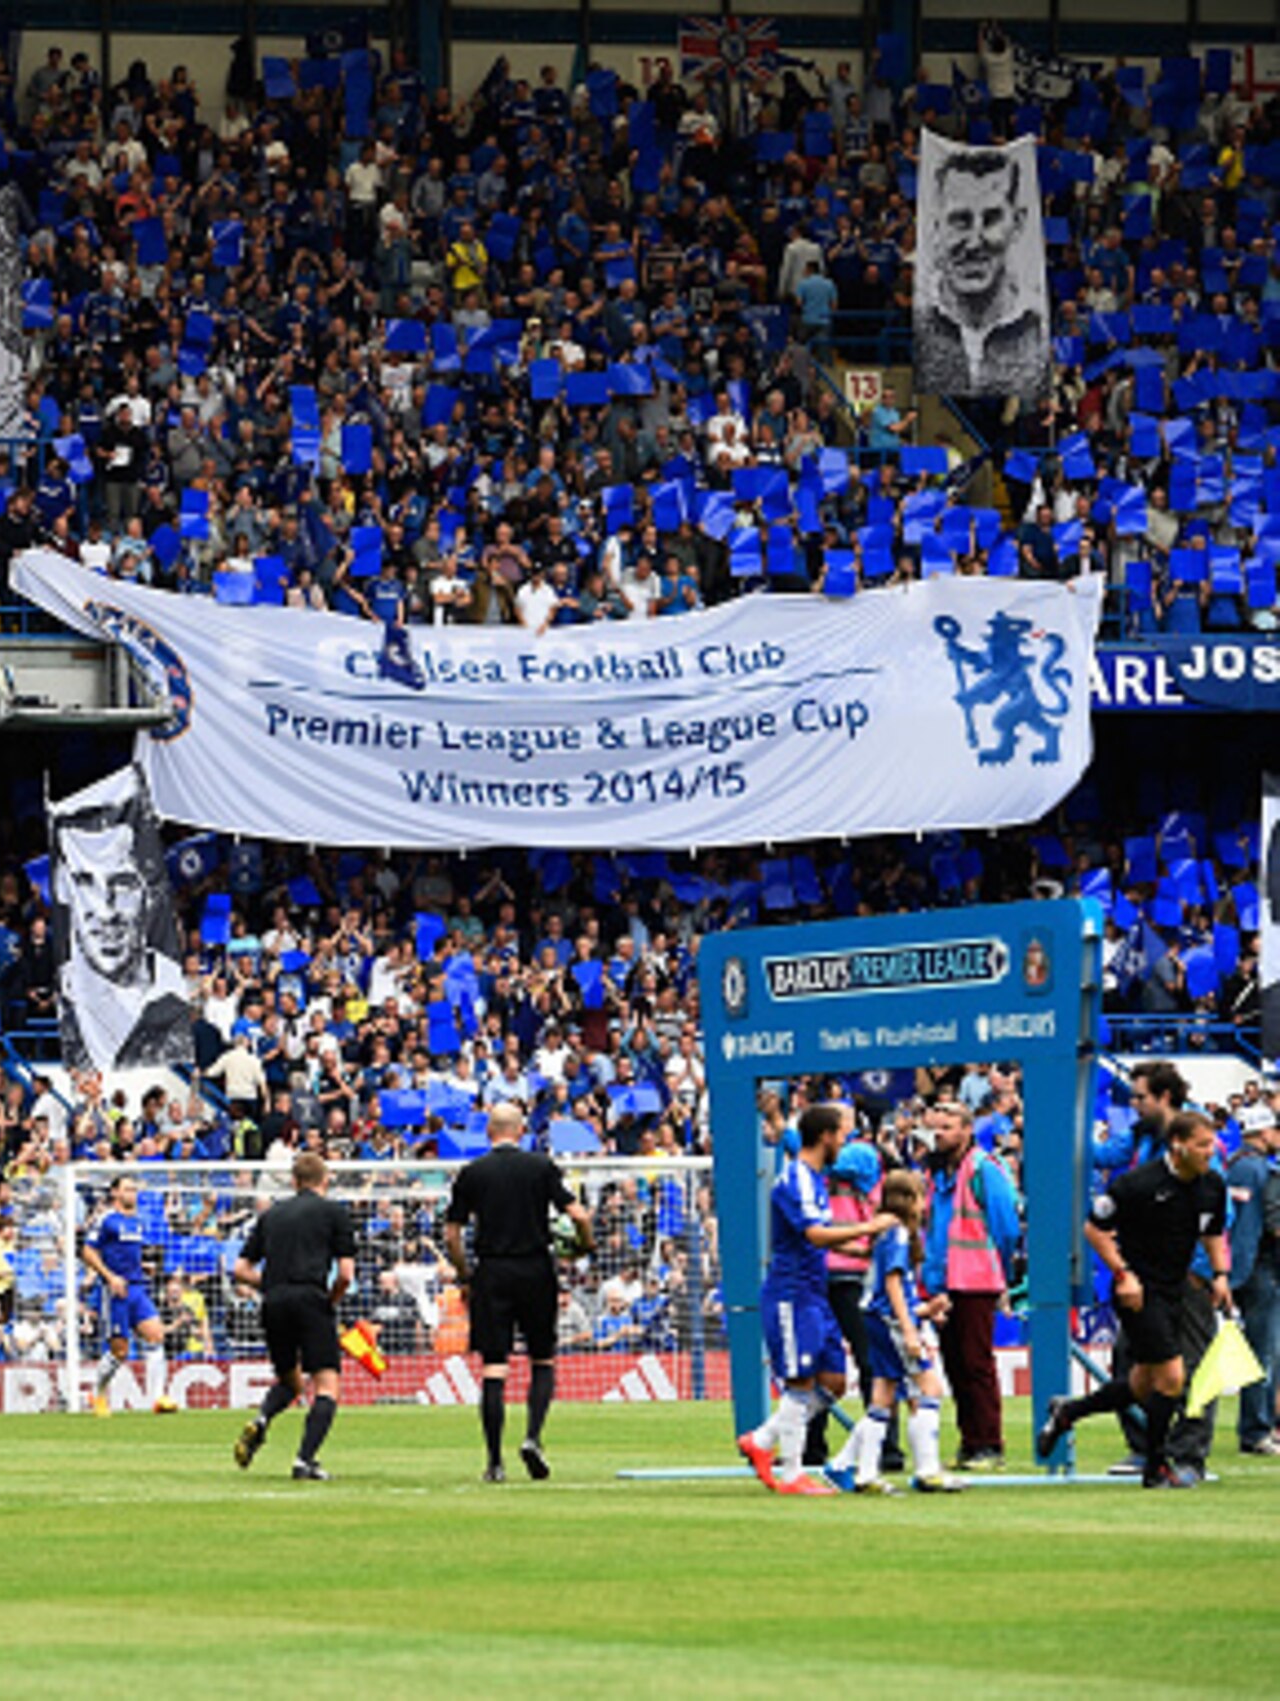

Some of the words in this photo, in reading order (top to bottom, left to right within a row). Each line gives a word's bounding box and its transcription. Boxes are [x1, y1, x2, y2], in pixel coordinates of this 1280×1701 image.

[850, 375, 878, 400] 13
[343, 649, 507, 684] Clsea
[517, 645, 684, 684] Football
[697, 640, 787, 676] Club
[266, 702, 424, 750] Premier
[437, 719, 582, 763] League
[596, 716, 626, 749] &
[641, 711, 776, 753] League
[792, 698, 869, 740] Cup
[399, 769, 571, 808] Winners
[584, 760, 747, 804] 2014/15
[853, 951, 921, 985] PREMIER
[925, 945, 988, 979] LEAGUE
